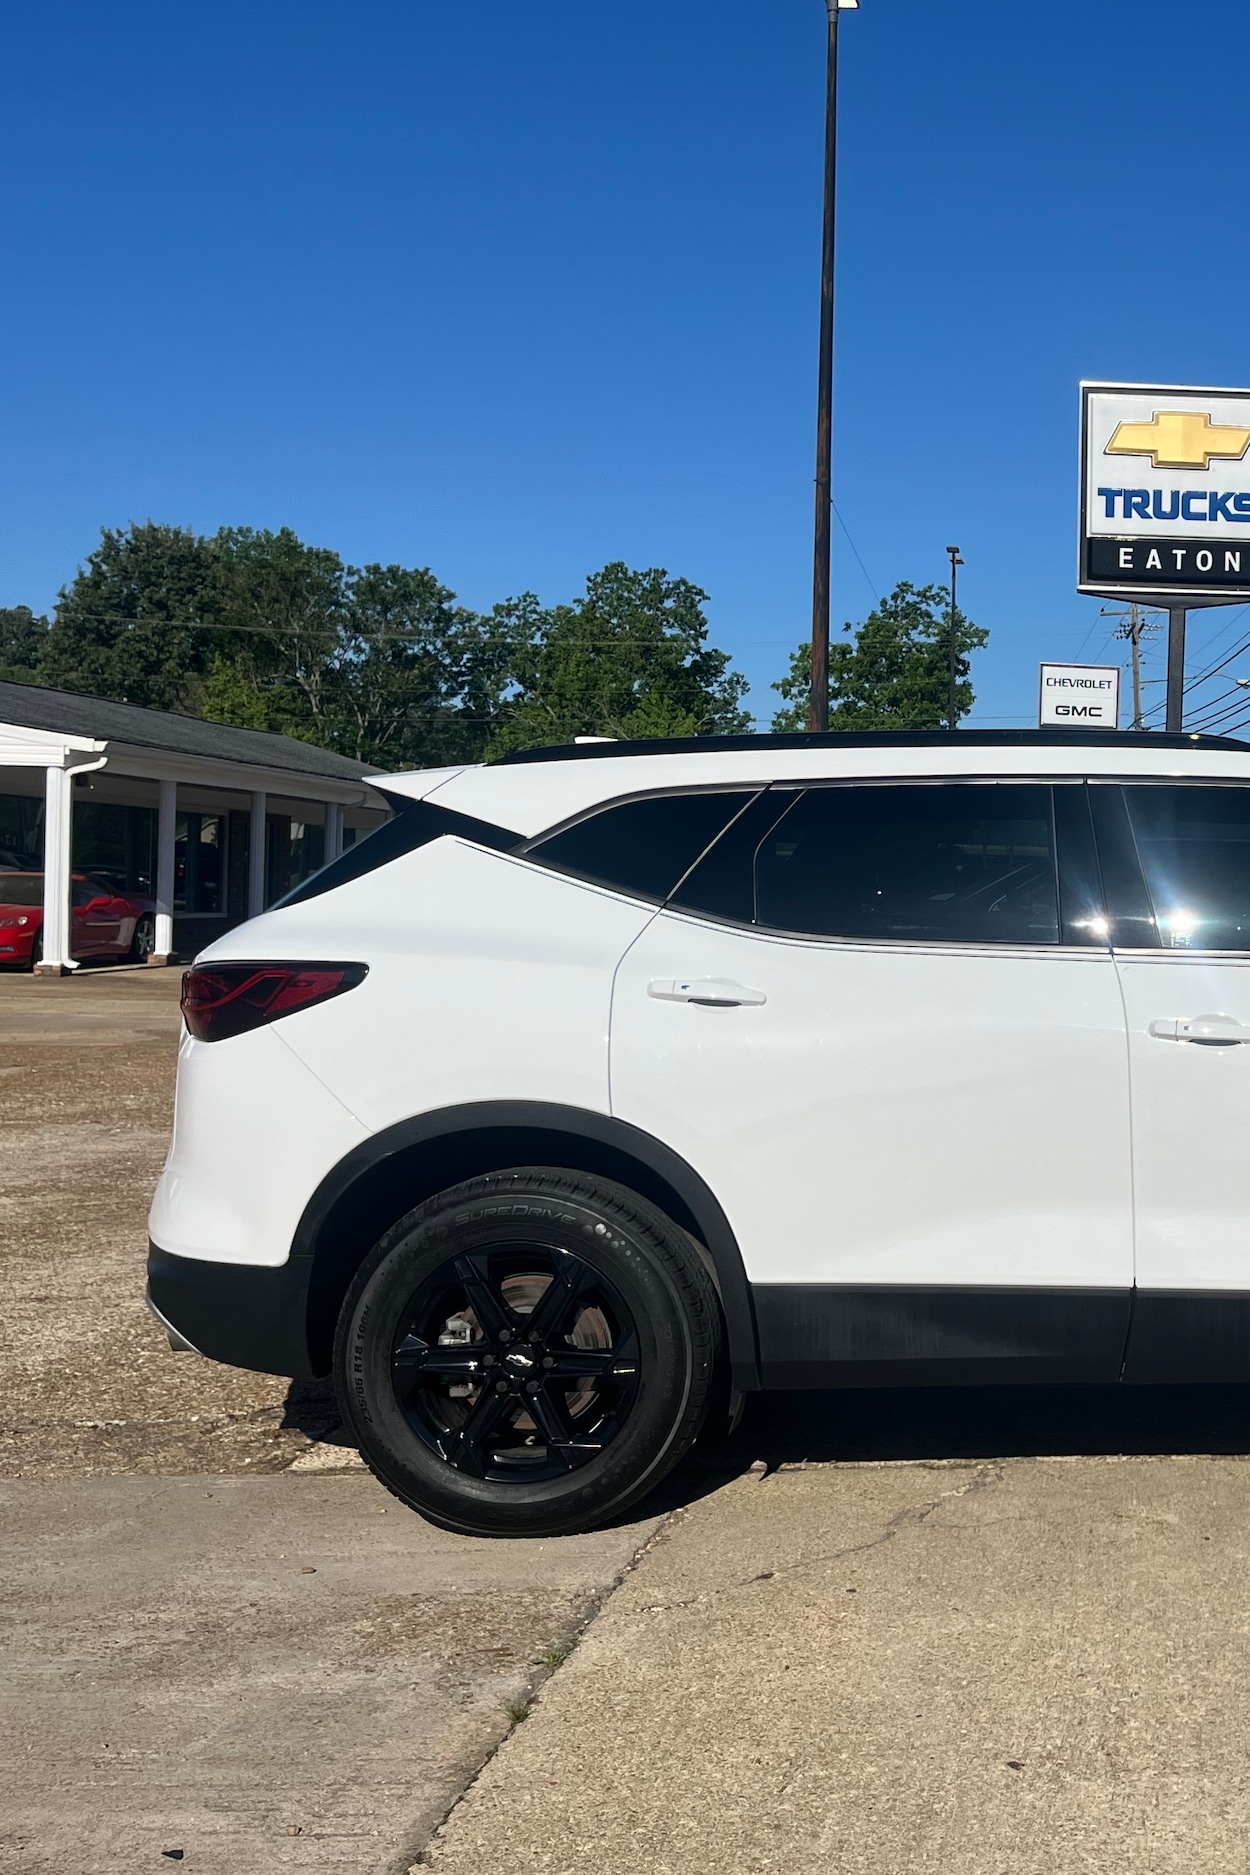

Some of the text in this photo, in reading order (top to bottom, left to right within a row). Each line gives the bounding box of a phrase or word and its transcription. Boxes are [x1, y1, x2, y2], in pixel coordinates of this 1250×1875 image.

[1118, 547, 1241, 572] EATON
[1046, 677, 1113, 690] CHEVROLET
[1055, 705, 1102, 717] GMC
[354, 1346, 363, 1373] R18
[355, 1378, 373, 1423] 235/65
